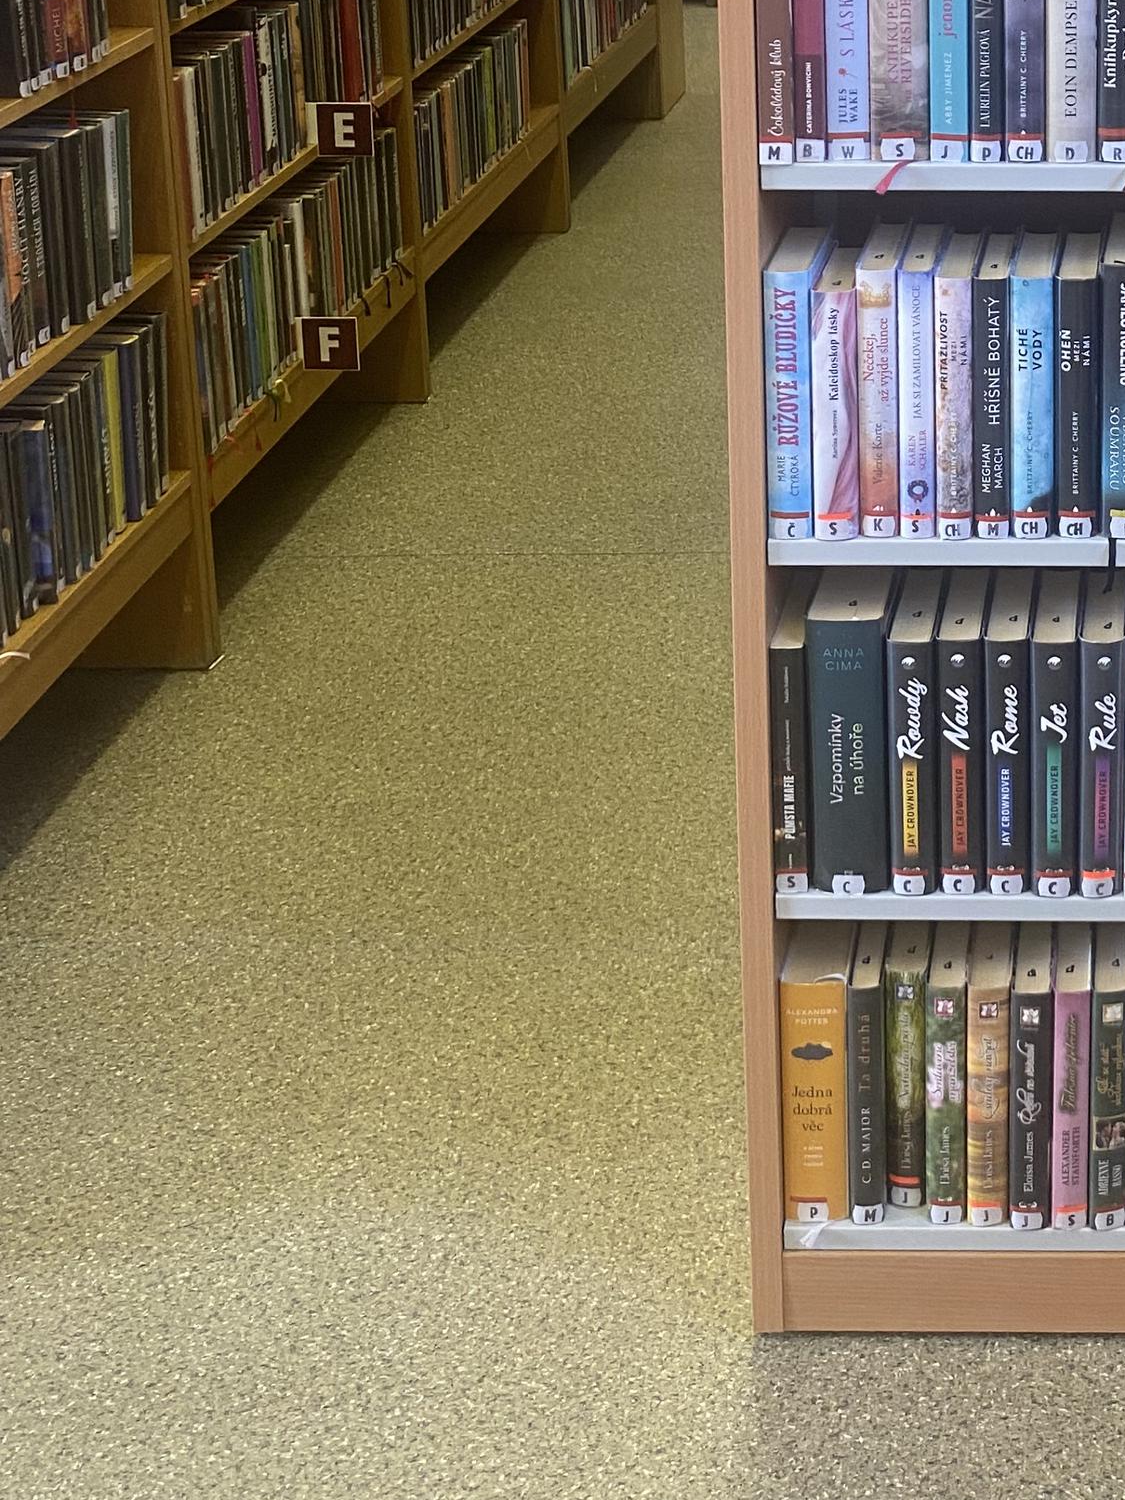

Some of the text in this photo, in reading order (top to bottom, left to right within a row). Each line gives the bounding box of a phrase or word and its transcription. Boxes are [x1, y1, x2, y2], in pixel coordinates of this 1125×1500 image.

[767, 39, 786, 136] Čokoládový klub
[978, 29, 990, 127] LAURELIN PAIGEOVÁ
[1065, 74, 1078, 117] EOIN
[333, 112, 356, 148] E
[318, 326, 340, 362] F
[982, 296, 1001, 424] HŘÍŠNĚ BOHATÝ
[1016, 329, 1028, 371] TICHÉ
[1032, 331, 1042, 370] VODY
[1059, 330, 1071, 371] OHEŇ
[1081, 334, 1090, 366] NÁMI
[982, 444, 991, 492] MEGHAN
[993, 448, 1003, 488] MARCH
[896, 677, 926, 759] Rowdy
[942, 685, 970, 750] Nash
[991, 685, 1020, 754] Rome
[1041, 703, 1068, 743] Jet
[1089, 692, 1118, 750] Rule
[828, 713, 845, 803] Vzpomínky
[850, 723, 864, 794] na úhoře
[906, 771, 916, 847] JAY CROWNOVER
[792, 1085, 833, 1098] Jedna
[793, 1106, 832, 1115] dobrá
[802, 1123, 824, 1131] věc
[1023, 1132, 1034, 1192] Eloisa James
